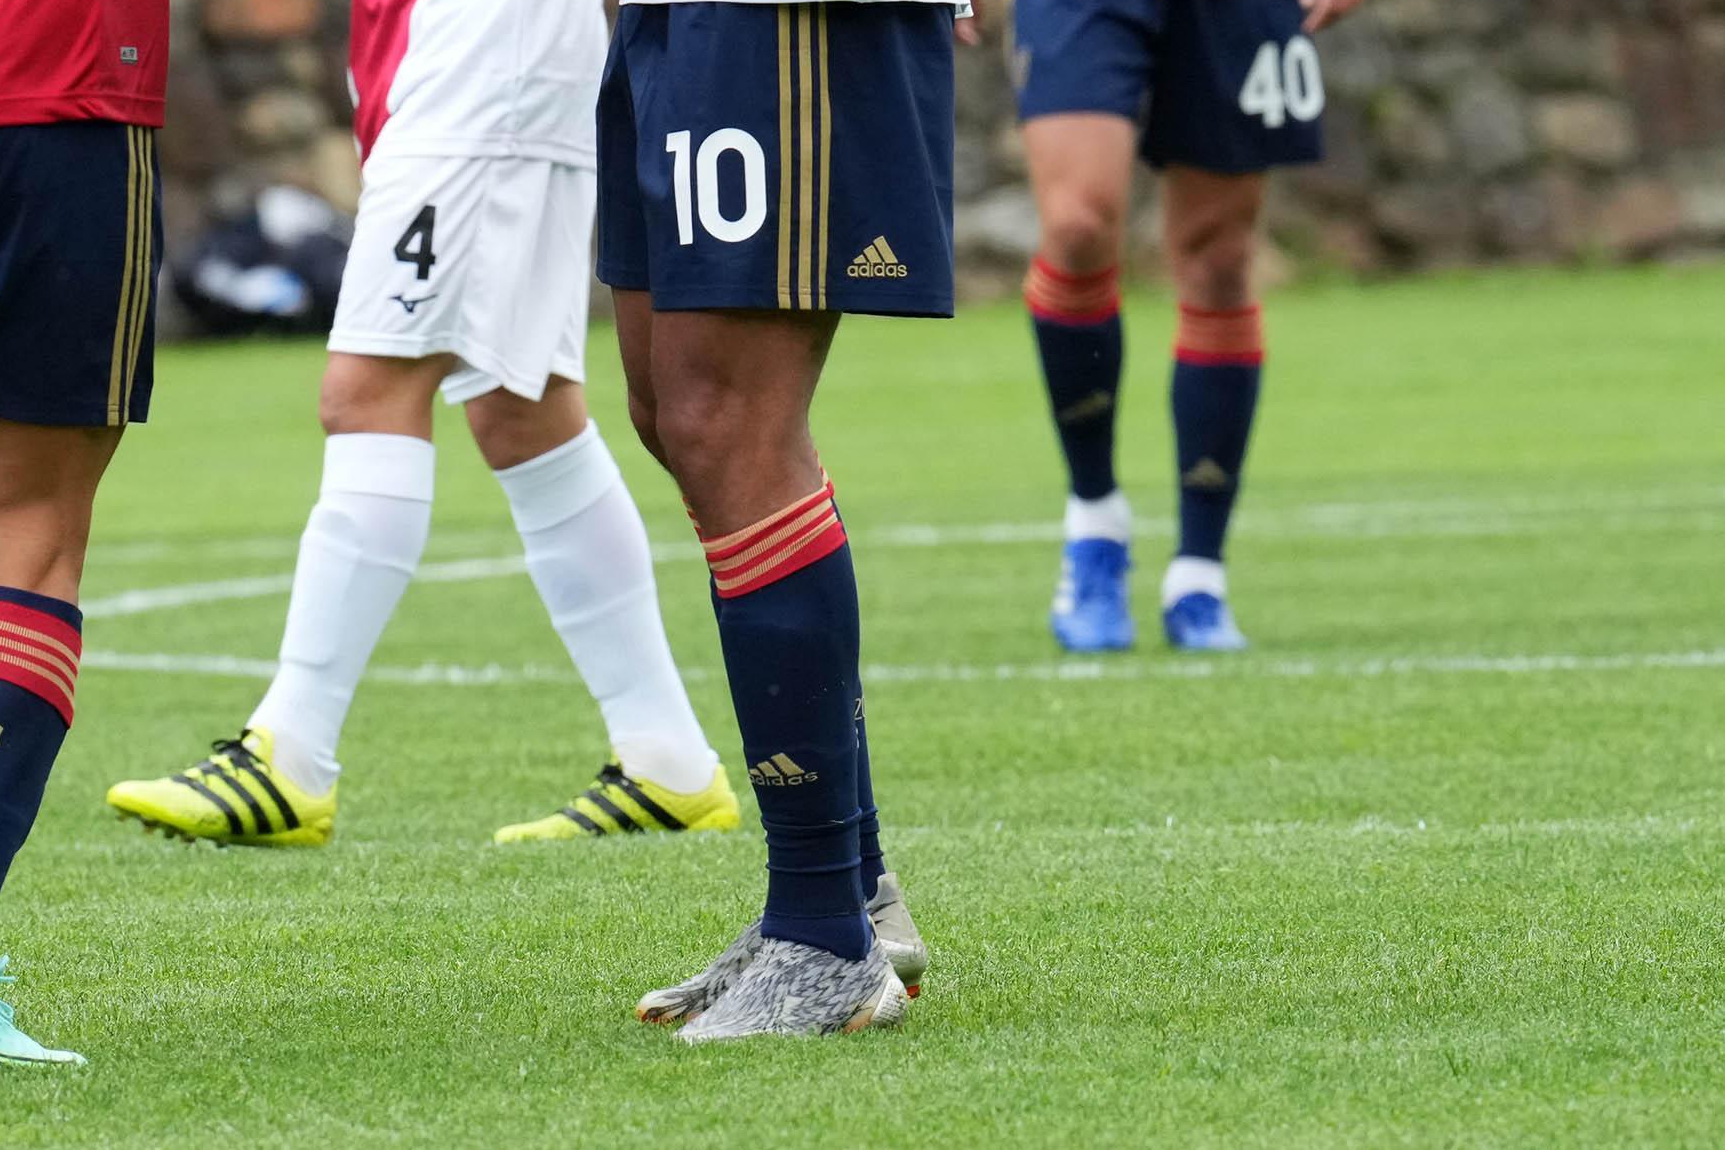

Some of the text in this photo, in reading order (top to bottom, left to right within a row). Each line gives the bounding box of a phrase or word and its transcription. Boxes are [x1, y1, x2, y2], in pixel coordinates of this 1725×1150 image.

[1238, 34, 1325, 129] 40
[666, 128, 767, 245] 10
[394, 205, 436, 280] 4
[846, 262, 908, 278] adidas
